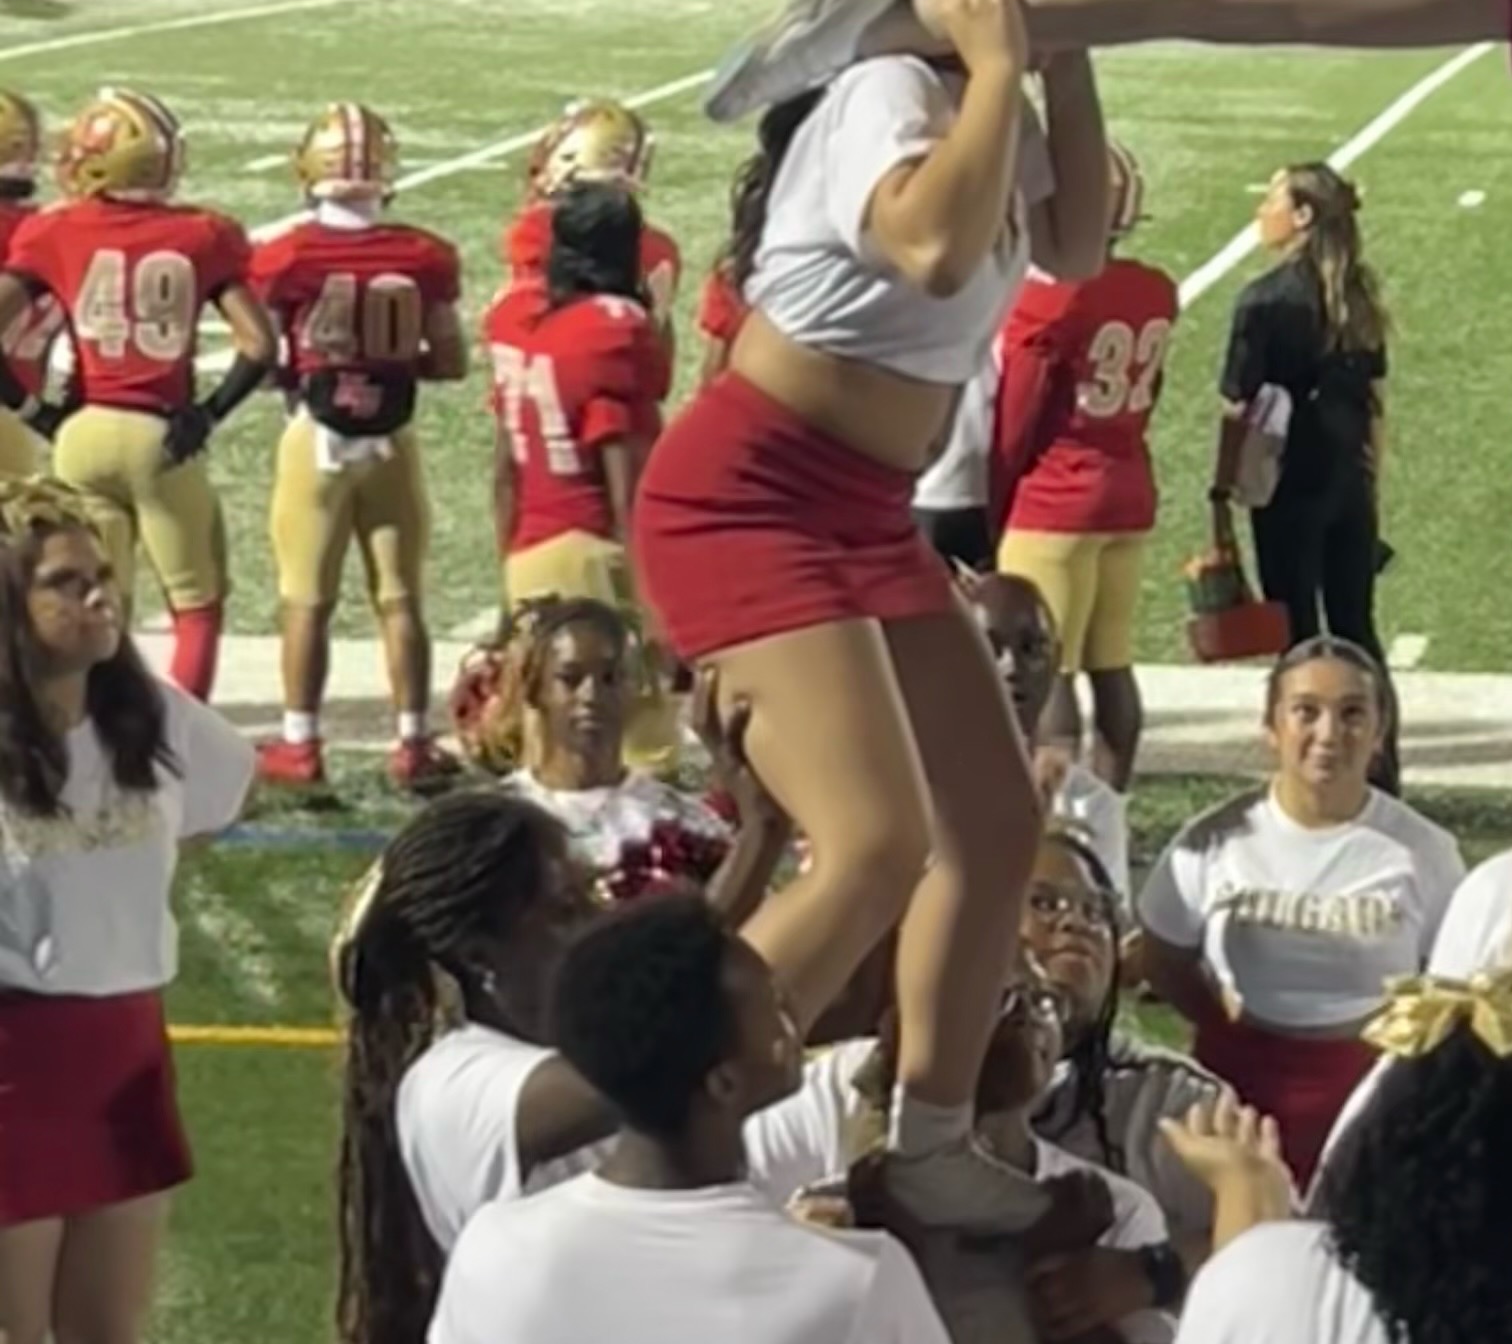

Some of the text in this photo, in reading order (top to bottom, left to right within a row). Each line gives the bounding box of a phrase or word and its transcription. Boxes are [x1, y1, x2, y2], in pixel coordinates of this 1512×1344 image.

[74, 247, 197, 362] 49
[299, 272, 422, 363] 40
[1075, 317, 1170, 418] 32
